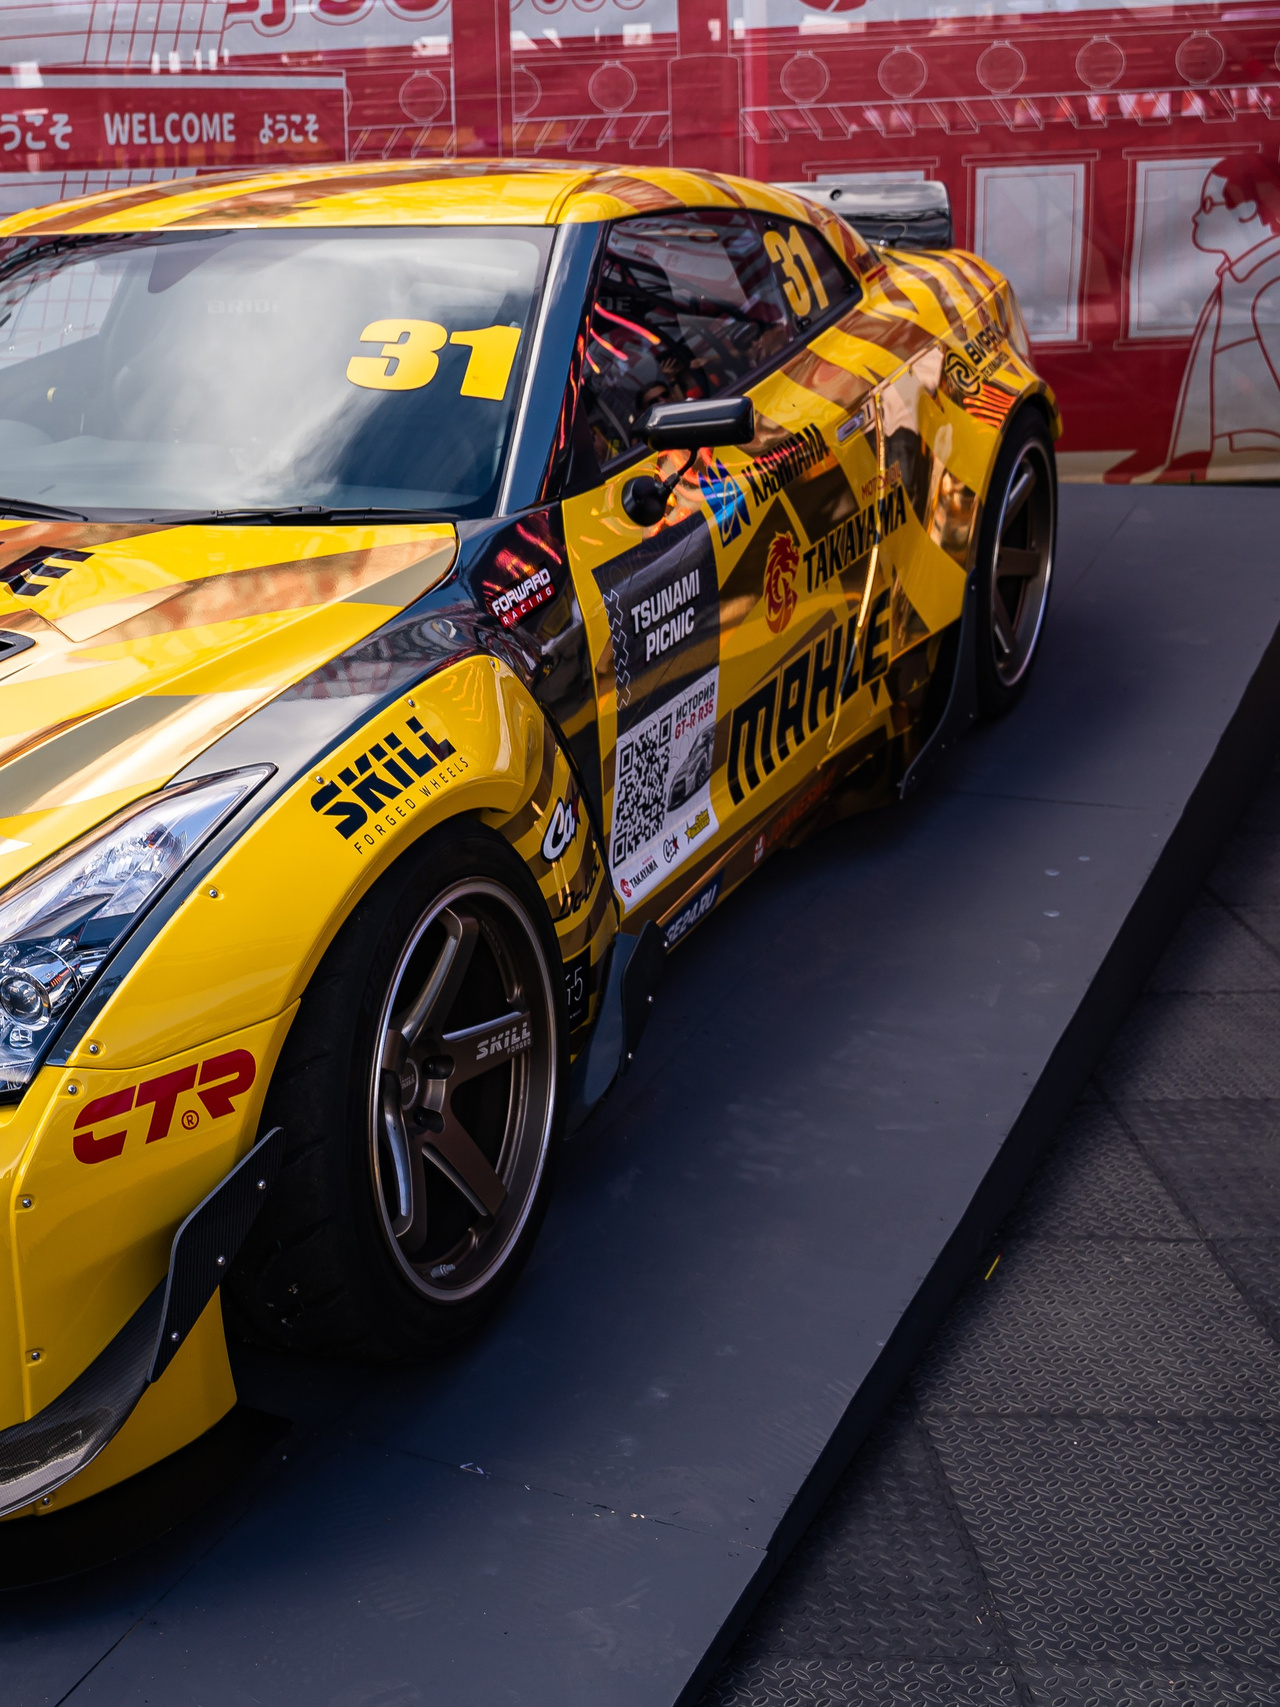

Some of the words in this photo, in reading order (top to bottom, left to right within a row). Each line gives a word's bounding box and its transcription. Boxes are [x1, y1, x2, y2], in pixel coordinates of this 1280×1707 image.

[104, 113, 236, 145] WELCOME
[259, 113, 319, 144] ようこそ
[763, 225, 829, 316] 31
[346, 319, 521, 401] 31
[803, 484, 907, 593] TAKAYAMA
[492, 568, 551, 616] FORWARD
[503, 587, 552, 625] RACING
[631, 568, 700, 634] TSUNAMI
[645, 607, 695, 662] PICNIC
[674, 713, 696, 740] GT-R
[698, 698, 715, 723] R35
[675, 681, 716, 723] ИСТОРИЯ
[727, 586, 892, 806] MAHLE
[310, 716, 457, 840] SKILL
[354, 798, 416, 855] FORGED
[421, 756, 469, 798] WHEELS
[629, 859, 658, 889] TAKAYAMA
[476, 1022, 531, 1060] SKILL
[507, 1038, 531, 1054] FORGED
